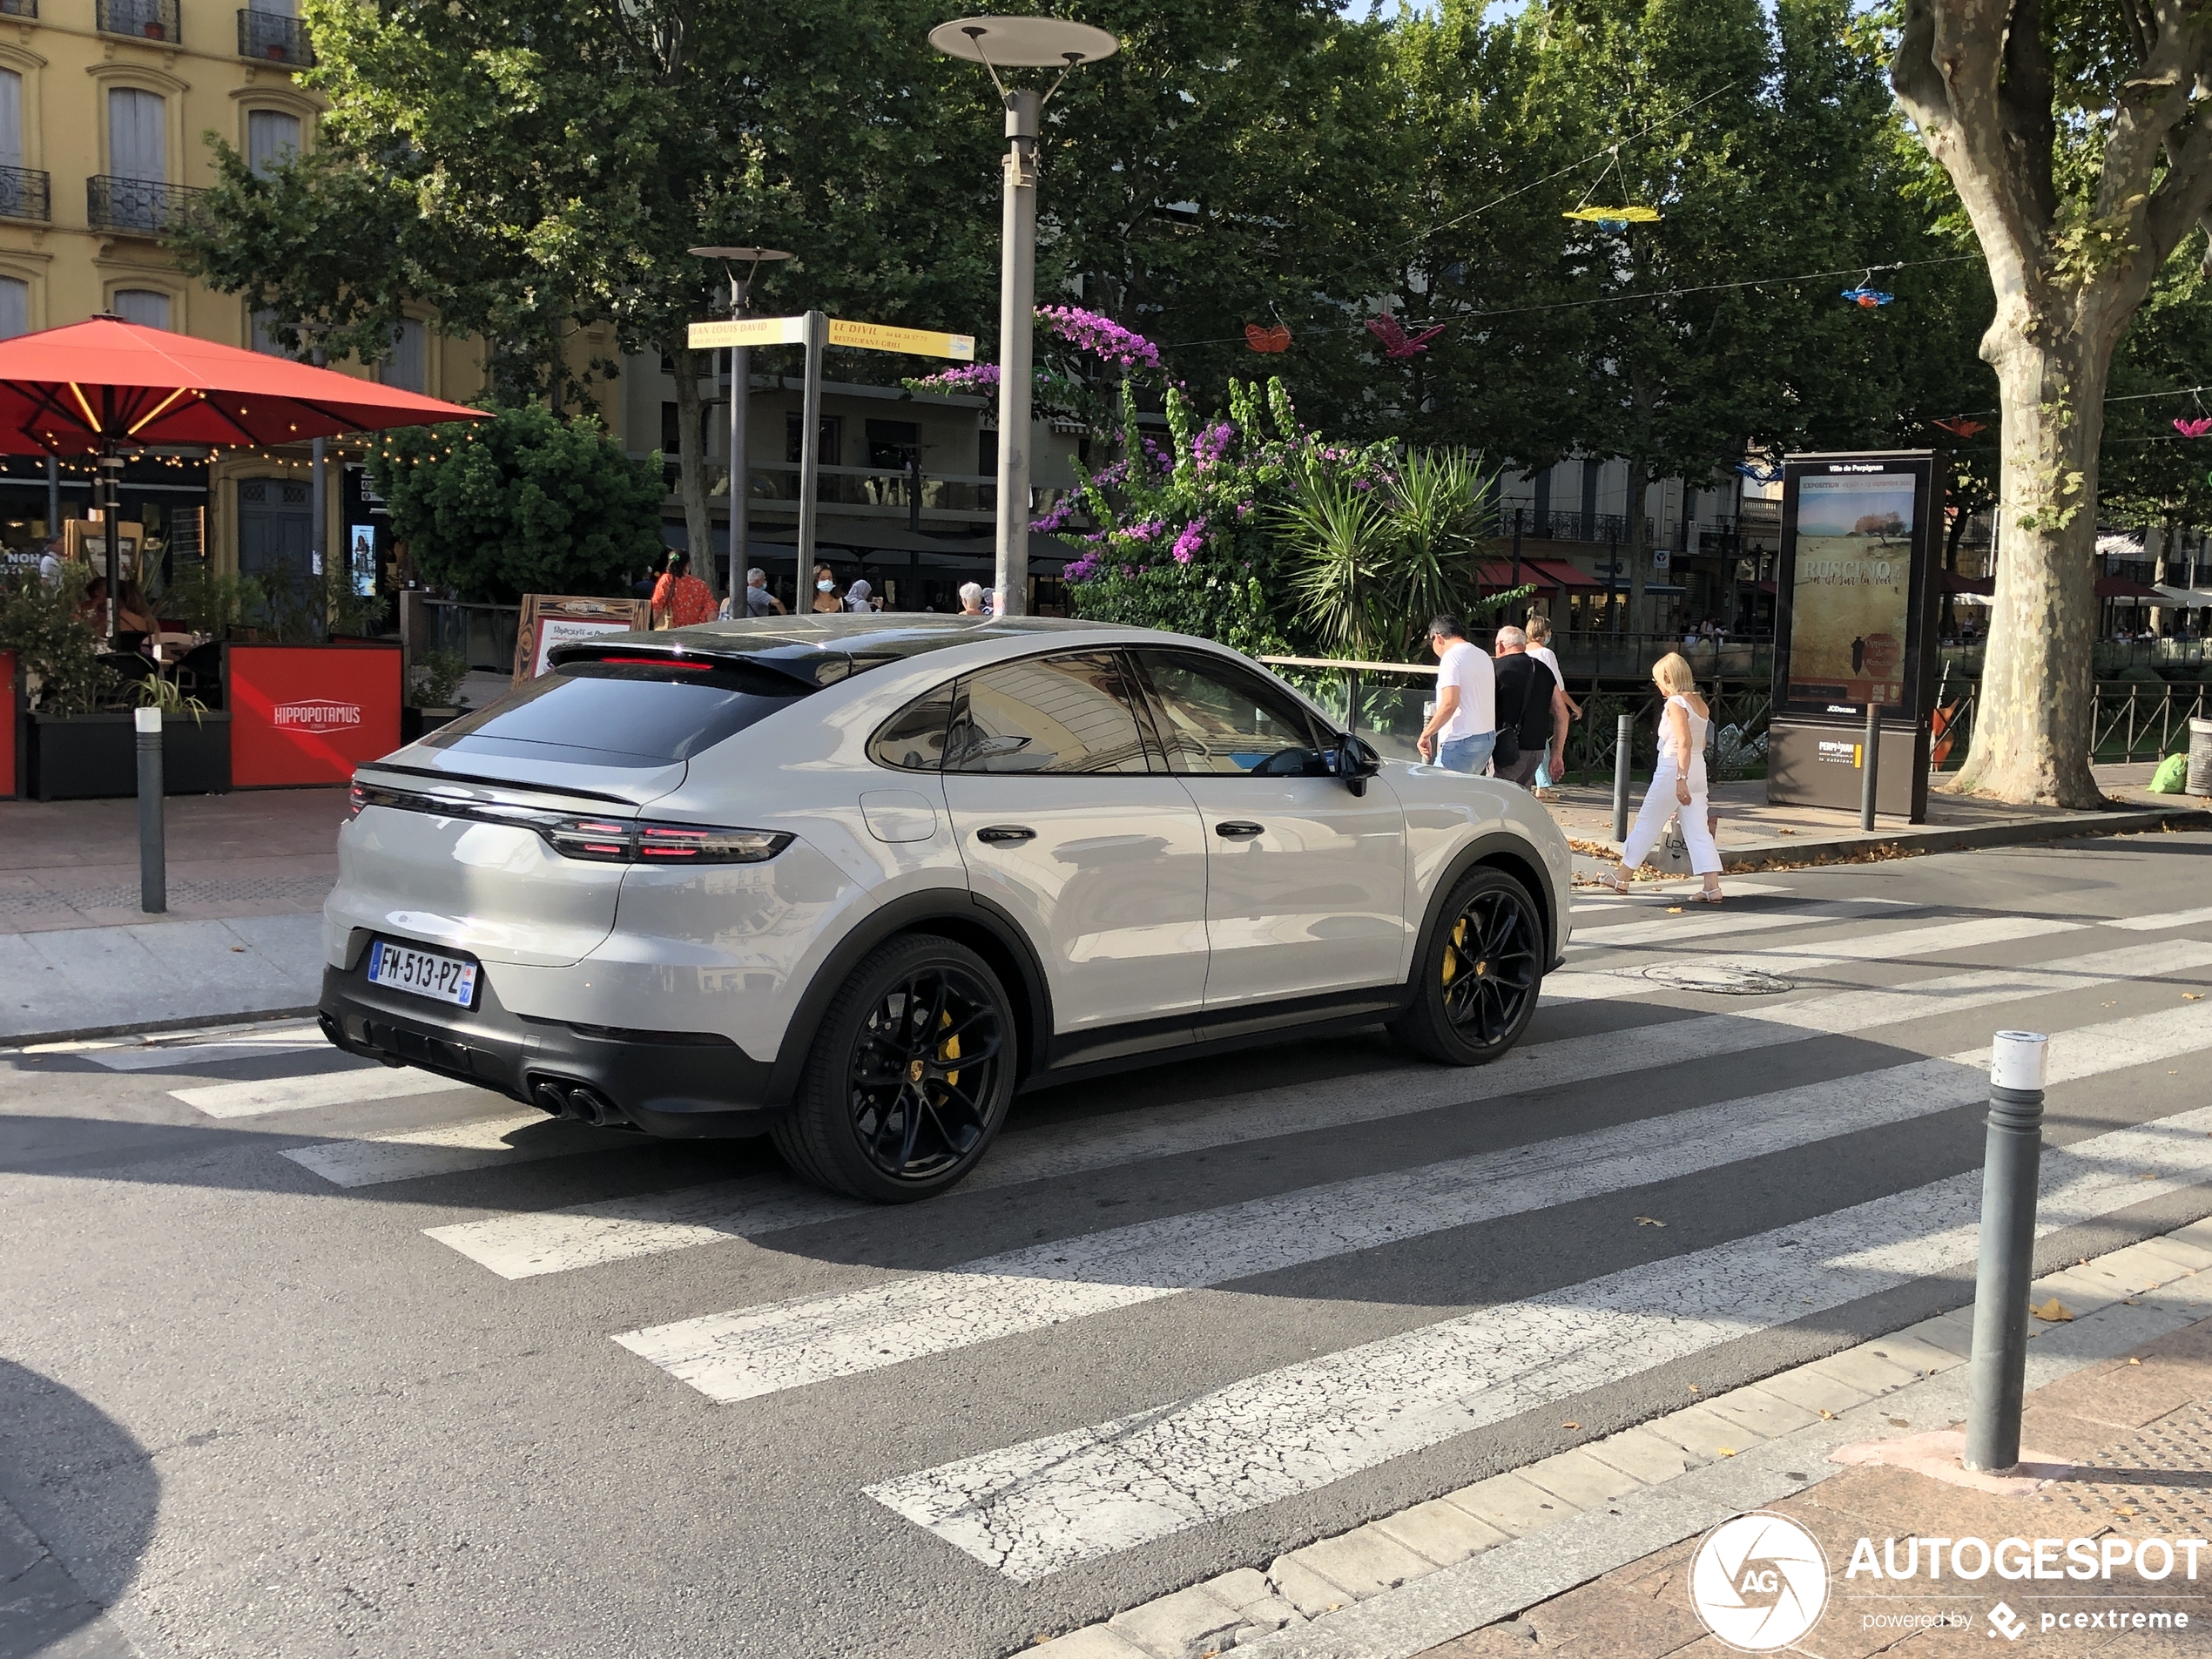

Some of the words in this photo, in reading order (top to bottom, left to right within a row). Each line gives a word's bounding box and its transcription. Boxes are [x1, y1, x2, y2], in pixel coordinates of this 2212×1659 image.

[690, 325, 710, 336] JEAN
[712, 323, 738, 334] LOUIS
[740, 322, 767, 333] DAVID
[833, 322, 846, 332] LE
[848, 325, 879, 336] DIVIL
[1852, 464, 1884, 473] Perpignan
[1804, 561, 1891, 578] RUSCINO
[1865, 640, 1897, 649] Oppidum
[274, 706, 361, 725] HIPPOPOTAMUS
[1827, 705, 1857, 714] JCDecaux
[1818, 740, 1855, 754] PERPIGNAN
[379, 948, 462, 995] FH-513-PZ
